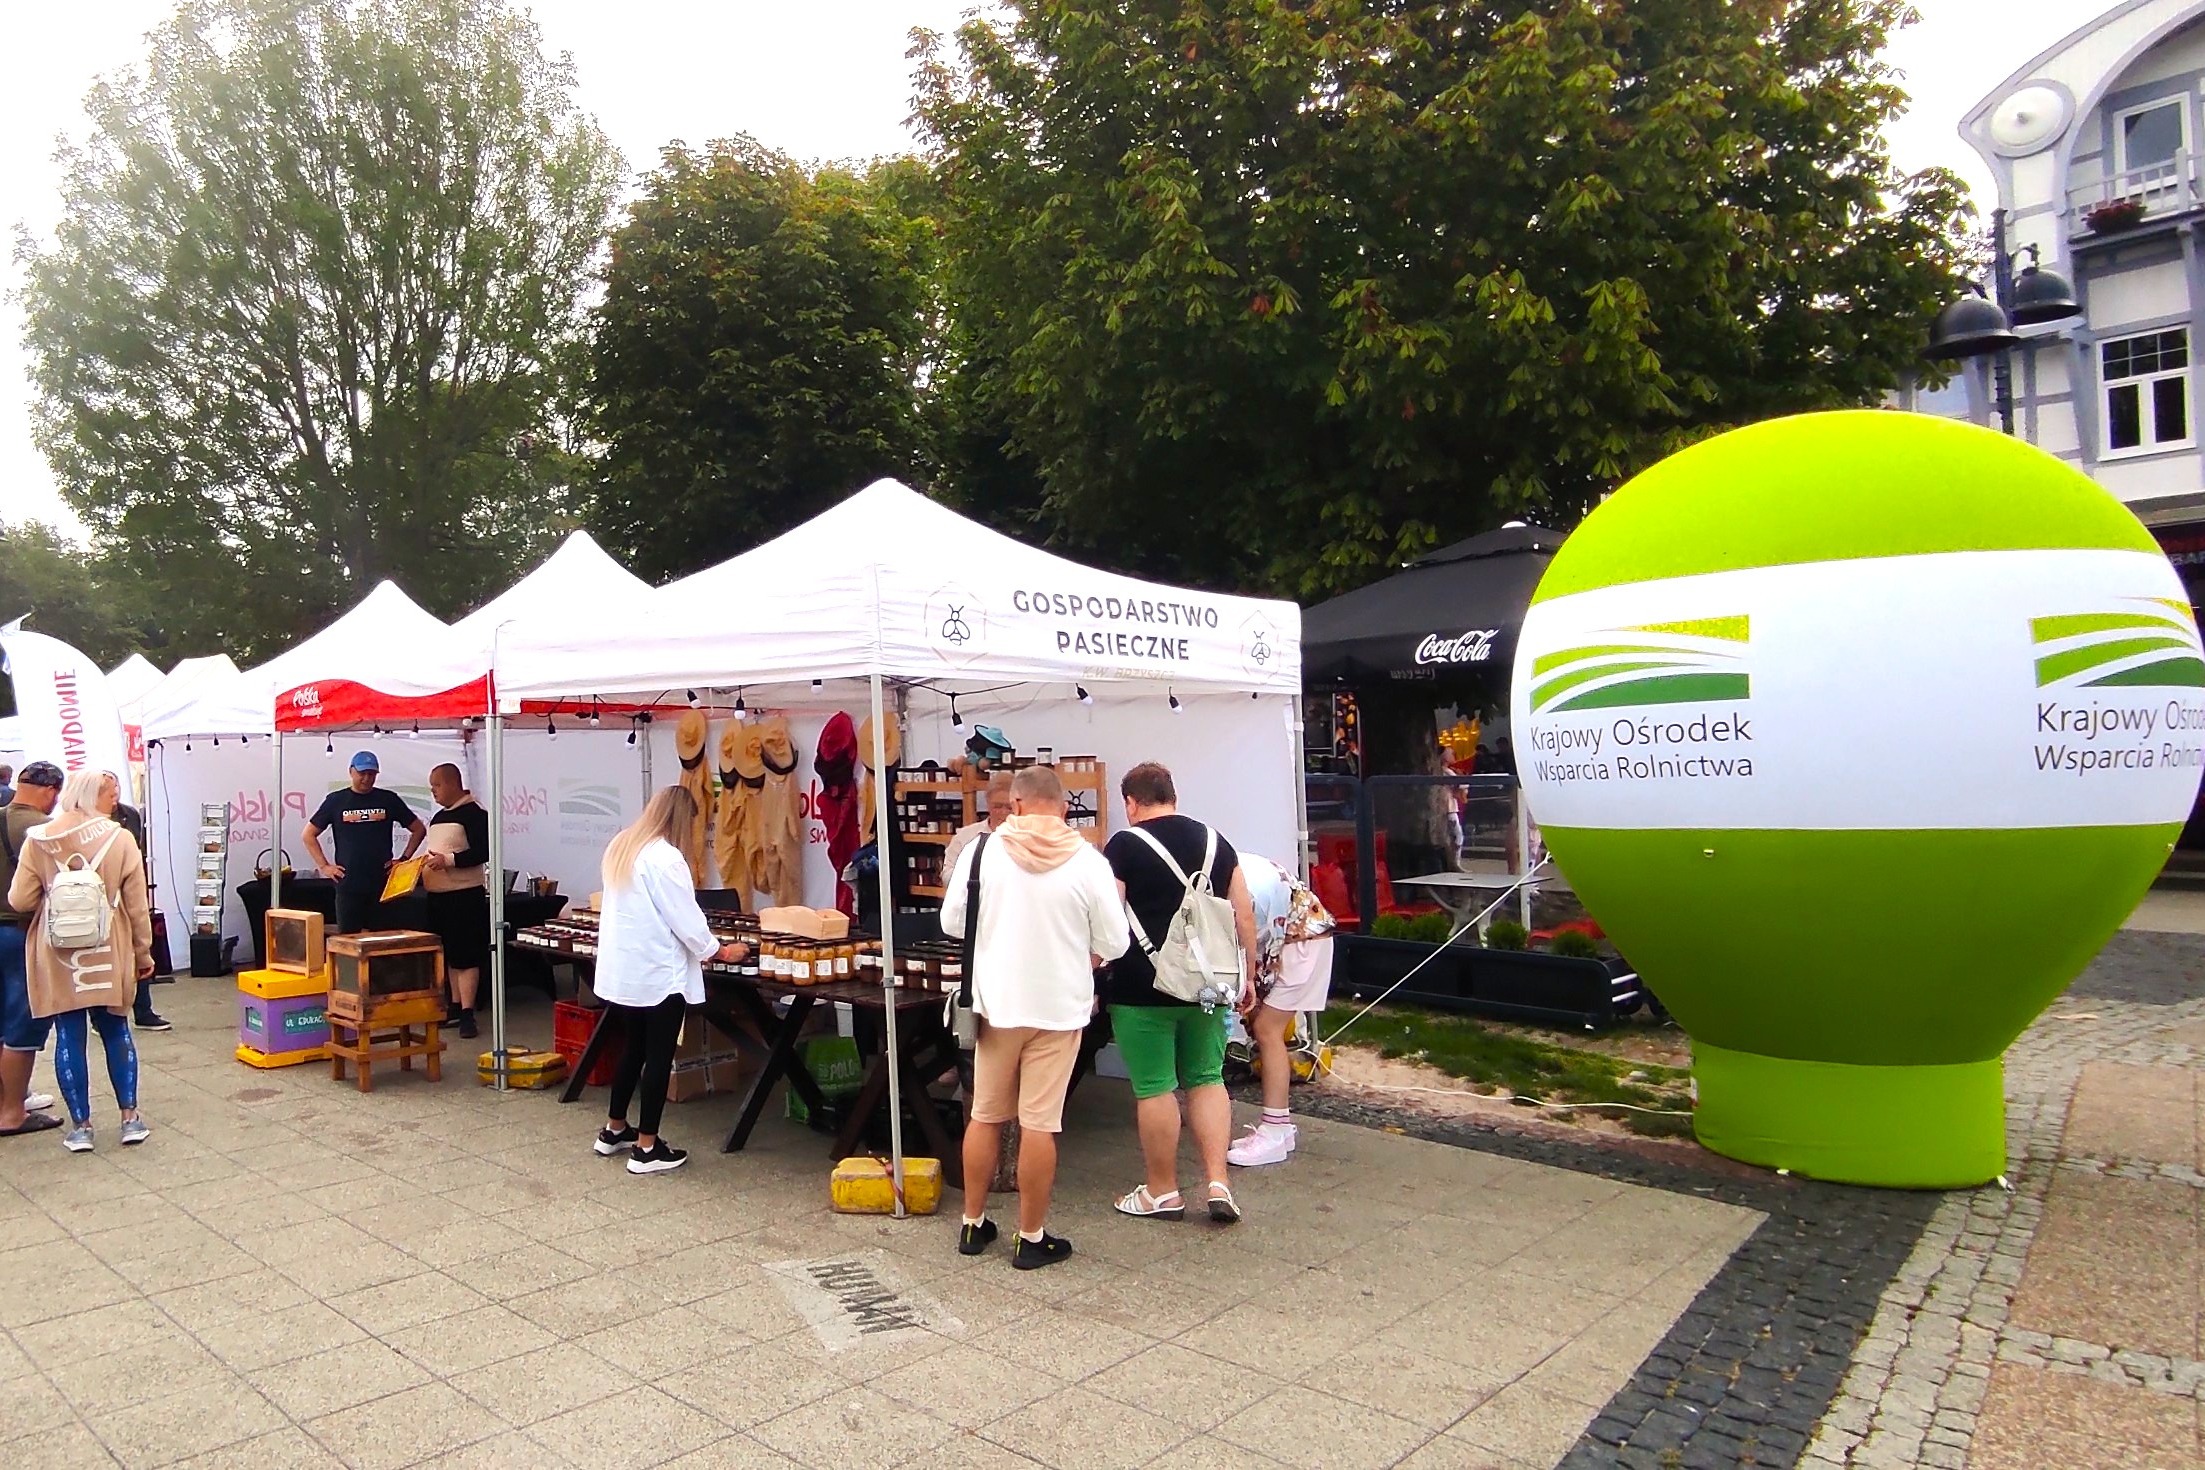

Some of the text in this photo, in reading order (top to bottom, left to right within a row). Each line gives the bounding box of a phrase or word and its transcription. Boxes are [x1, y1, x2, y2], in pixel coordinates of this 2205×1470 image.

[1012, 590, 1219, 629] GOSPODARSTWO
[1056, 630, 1190, 661] PASIECZNE
[1529, 711, 1754, 757] Krajowy Ośrodek
[2036, 700, 2158, 741] Krajowy
[1534, 753, 1754, 787] Wsparcia Rolnictwa
[2033, 742, 2154, 777] Wsparcia
